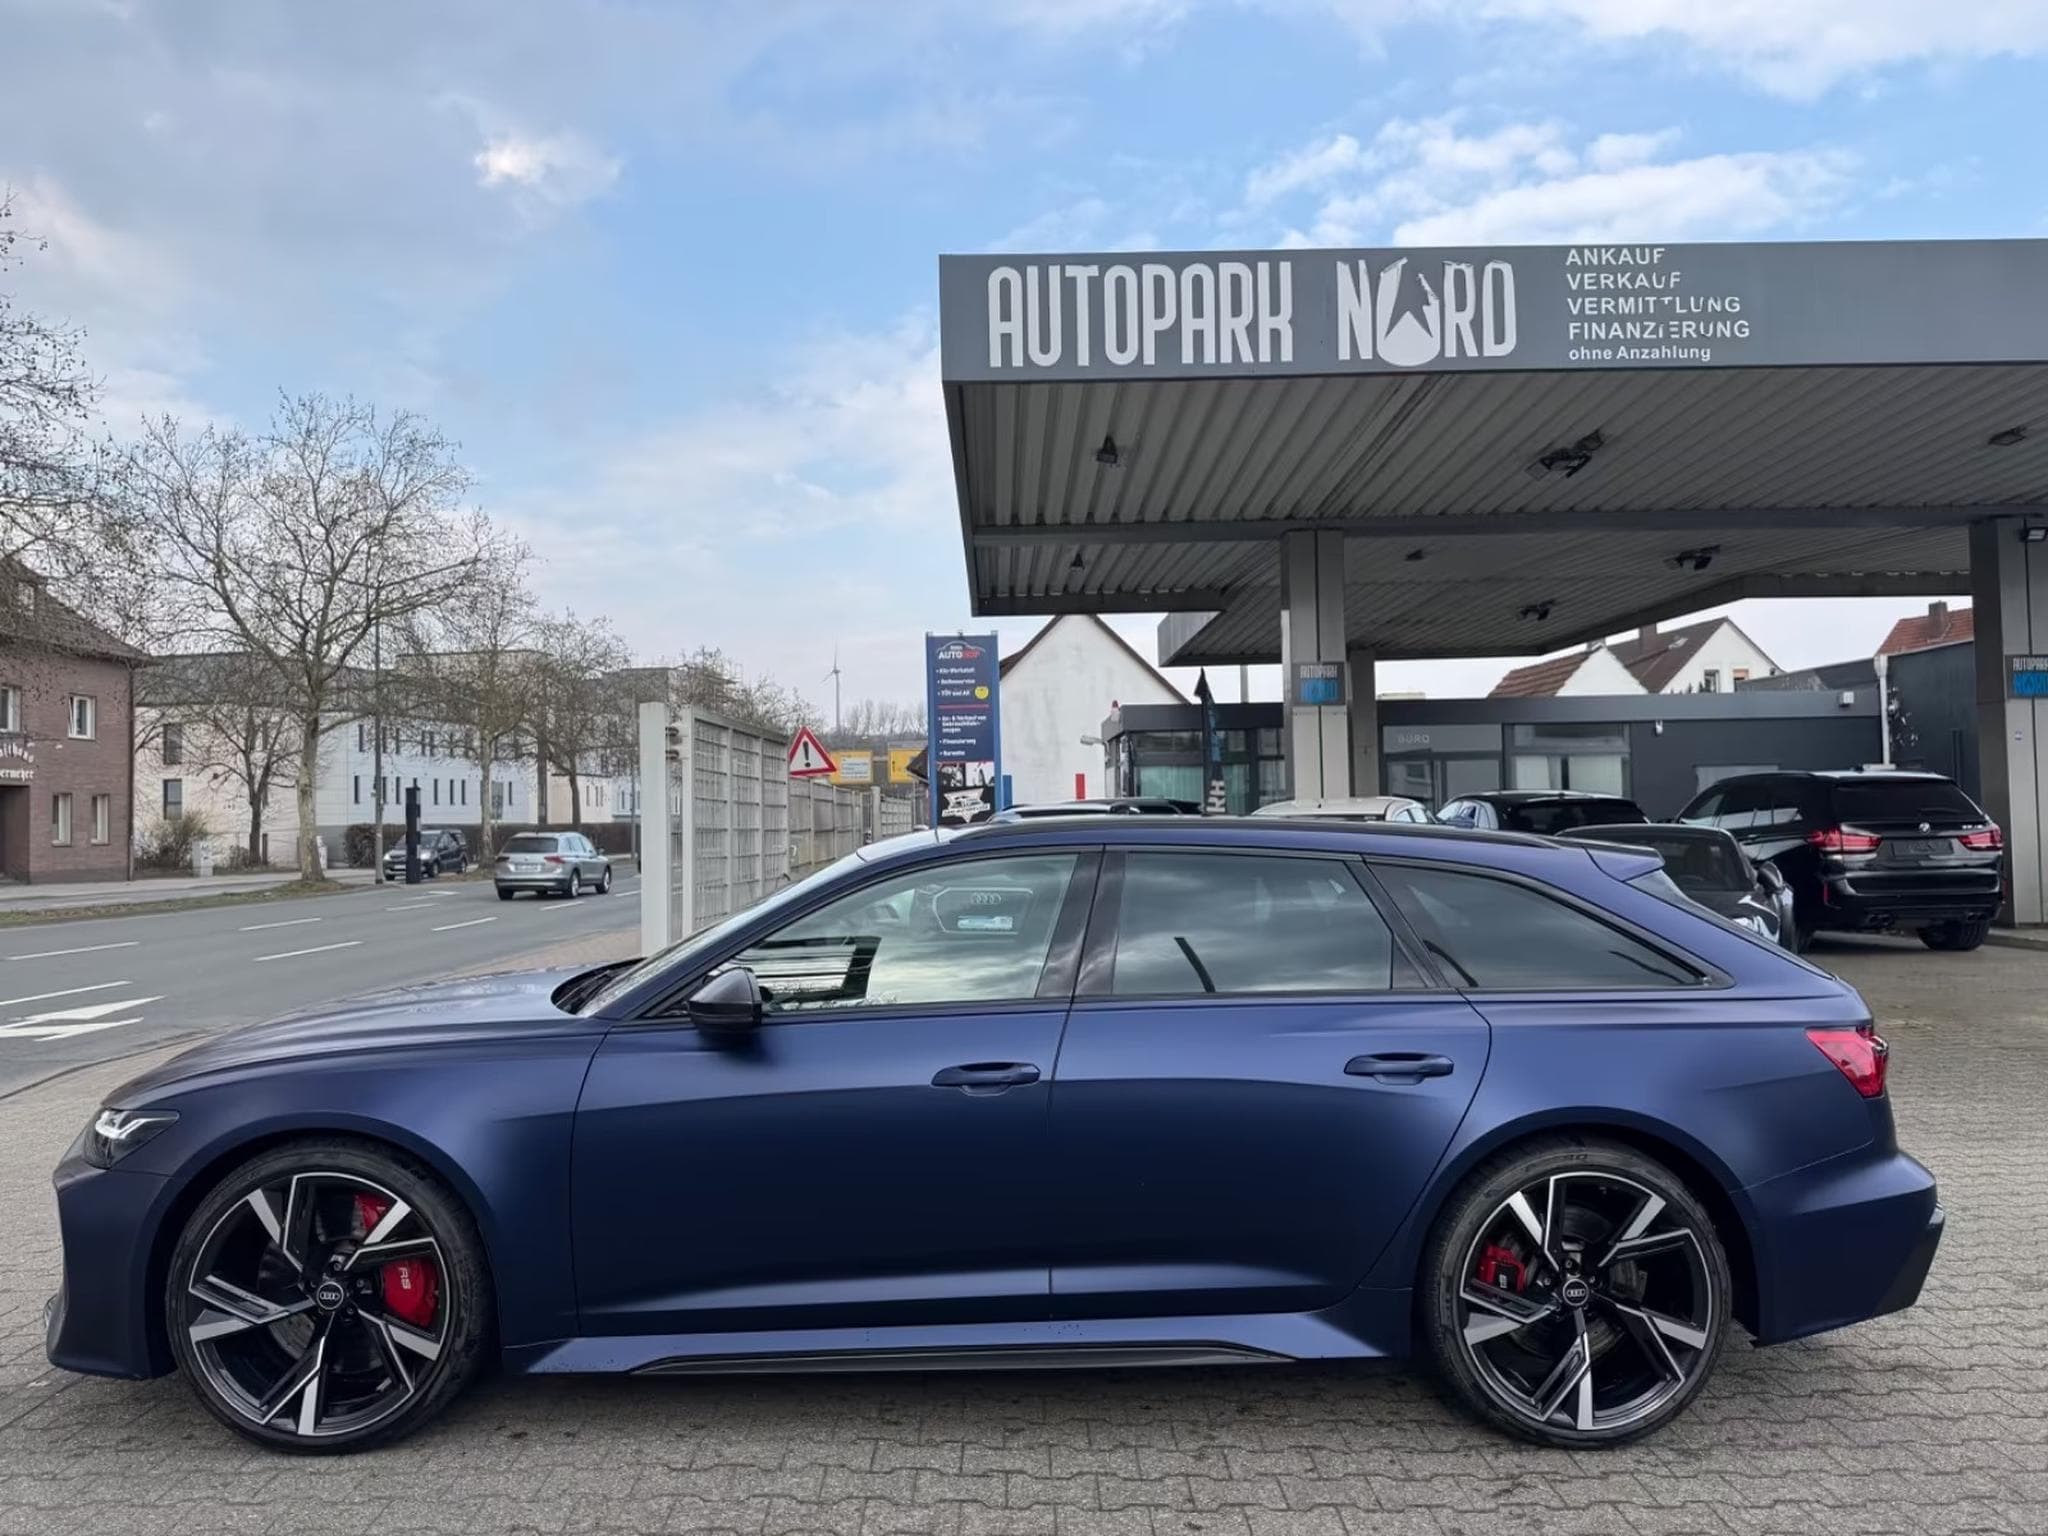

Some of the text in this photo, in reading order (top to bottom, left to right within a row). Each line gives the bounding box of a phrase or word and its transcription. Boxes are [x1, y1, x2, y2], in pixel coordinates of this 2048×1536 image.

[1565, 247, 1666, 266] ANKAUF
[1566, 271, 1682, 290] VERKAUF
[987, 261, 1294, 368] AUTOPARK
[1567, 296, 1742, 315] VERMITTLUNG
[1568, 320, 1751, 340] FINANZIERUNG
[1568, 345, 1712, 362] ohne Anzahlung
[398, 1266, 412, 1290] RS
